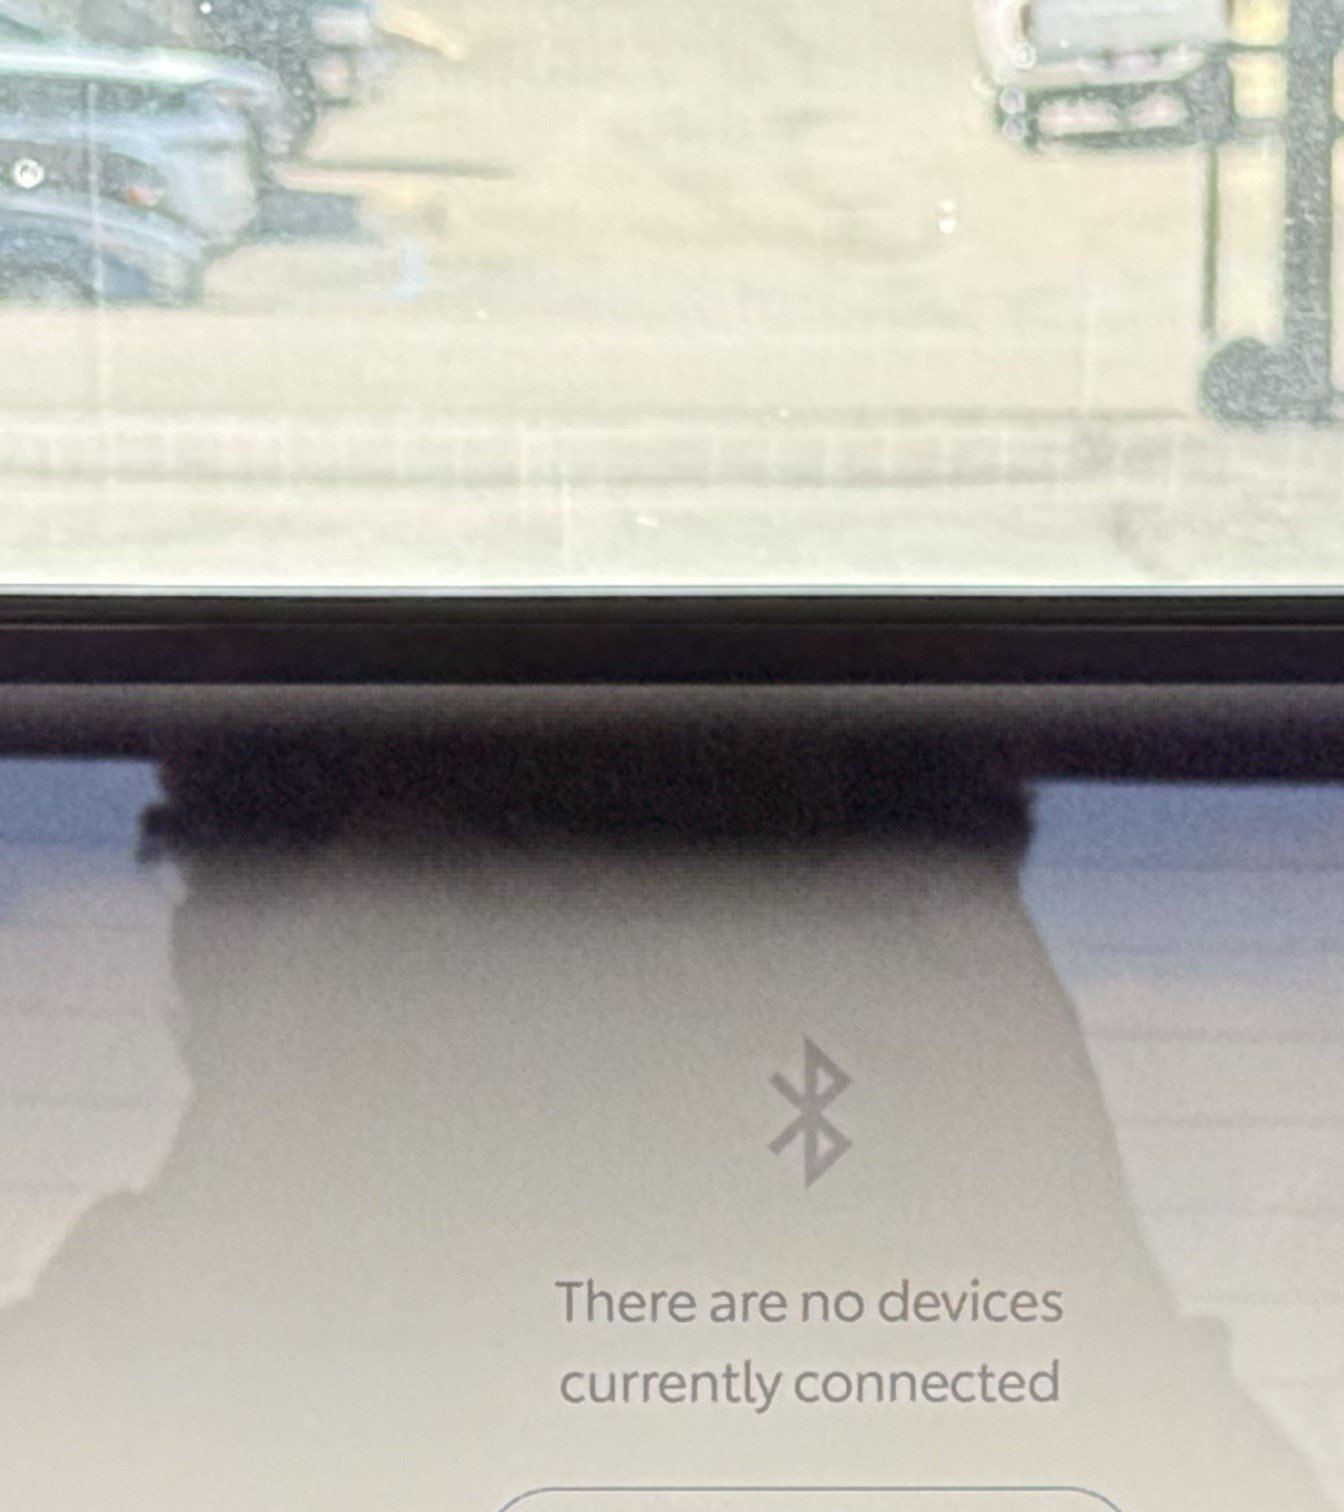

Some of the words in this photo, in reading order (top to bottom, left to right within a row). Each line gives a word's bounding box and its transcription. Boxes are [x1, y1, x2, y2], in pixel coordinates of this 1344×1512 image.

[554, 1278, 697, 1323] There
[709, 1289, 788, 1323] are
[801, 1289, 865, 1323] no
[878, 1277, 1064, 1323] devices
[559, 1358, 783, 1415] currently
[794, 1358, 1060, 1404] connected
